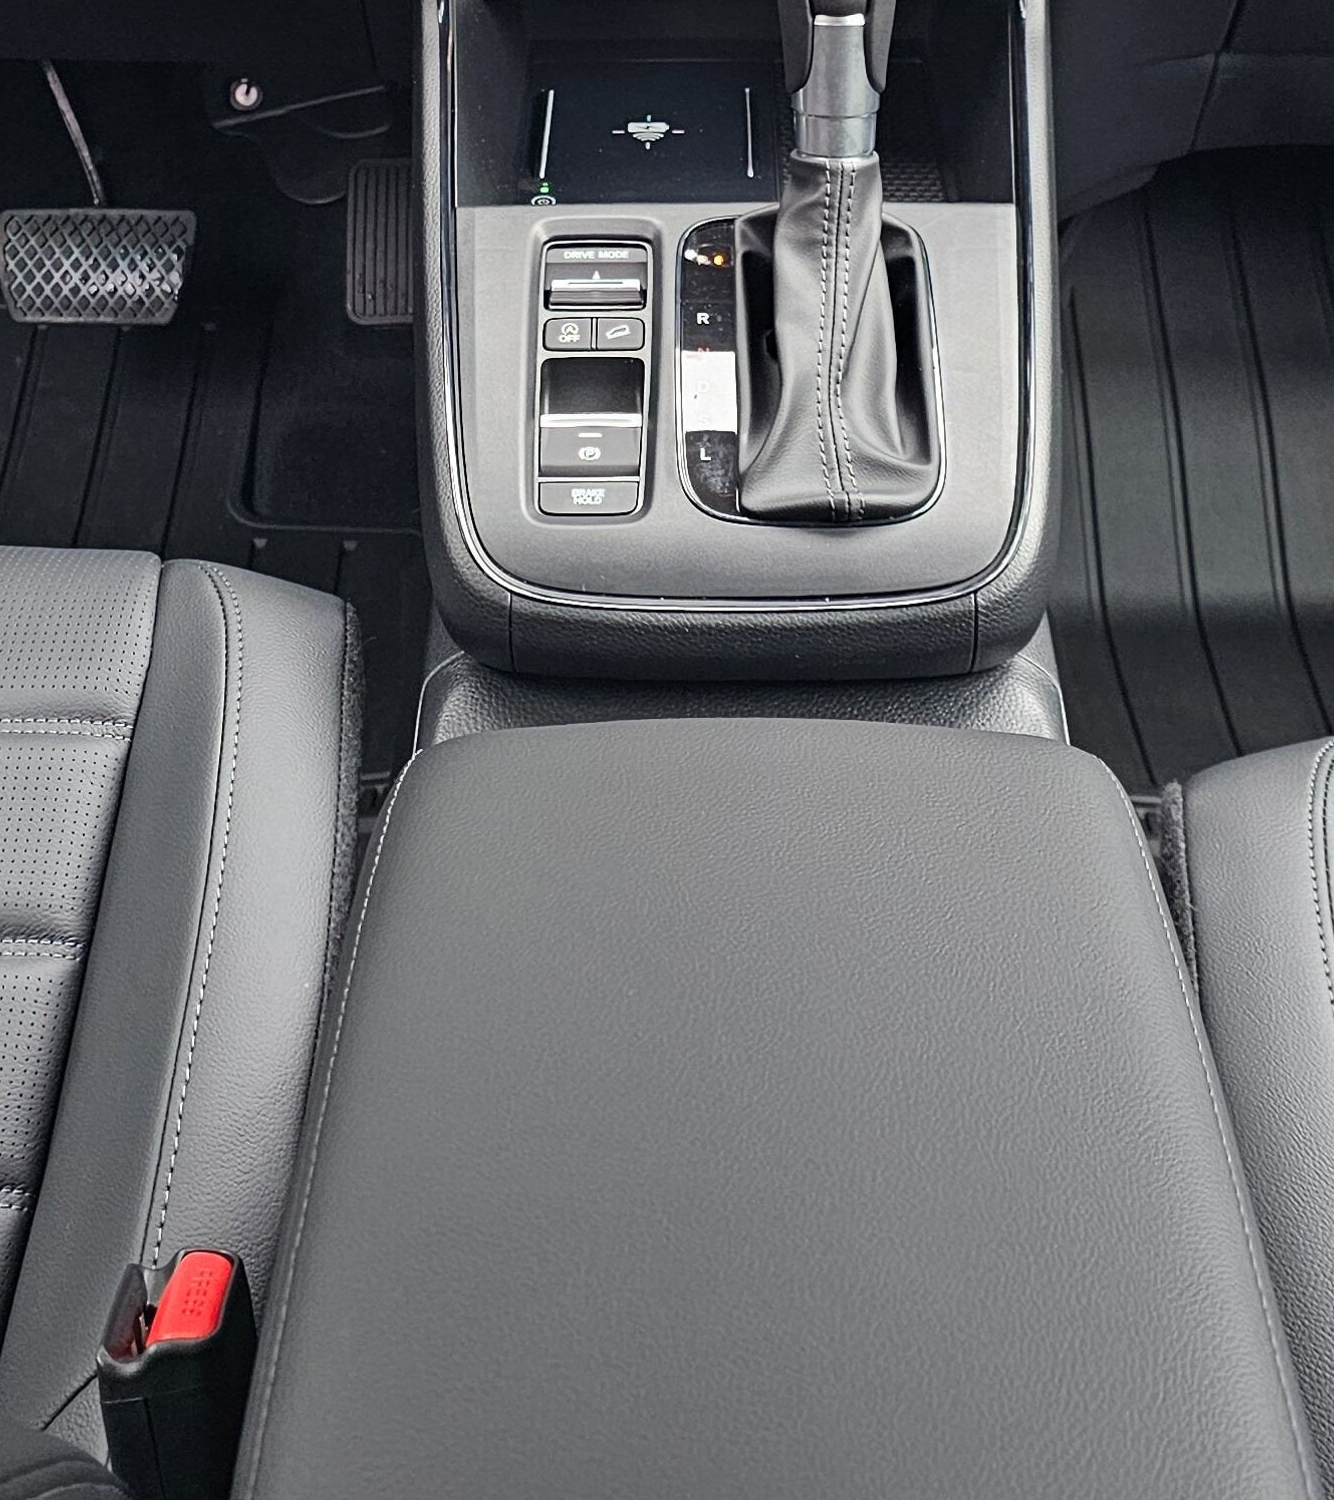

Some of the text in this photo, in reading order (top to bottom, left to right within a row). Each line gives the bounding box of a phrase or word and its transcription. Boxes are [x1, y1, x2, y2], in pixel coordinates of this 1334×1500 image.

[564, 250, 629, 259] DRIVE MODE
[697, 312, 710, 325] R
[559, 334, 580, 343] OFF
[700, 448, 712, 461] L
[571, 488, 605, 497] BRAKE
[573, 497, 603, 505] HOLD
